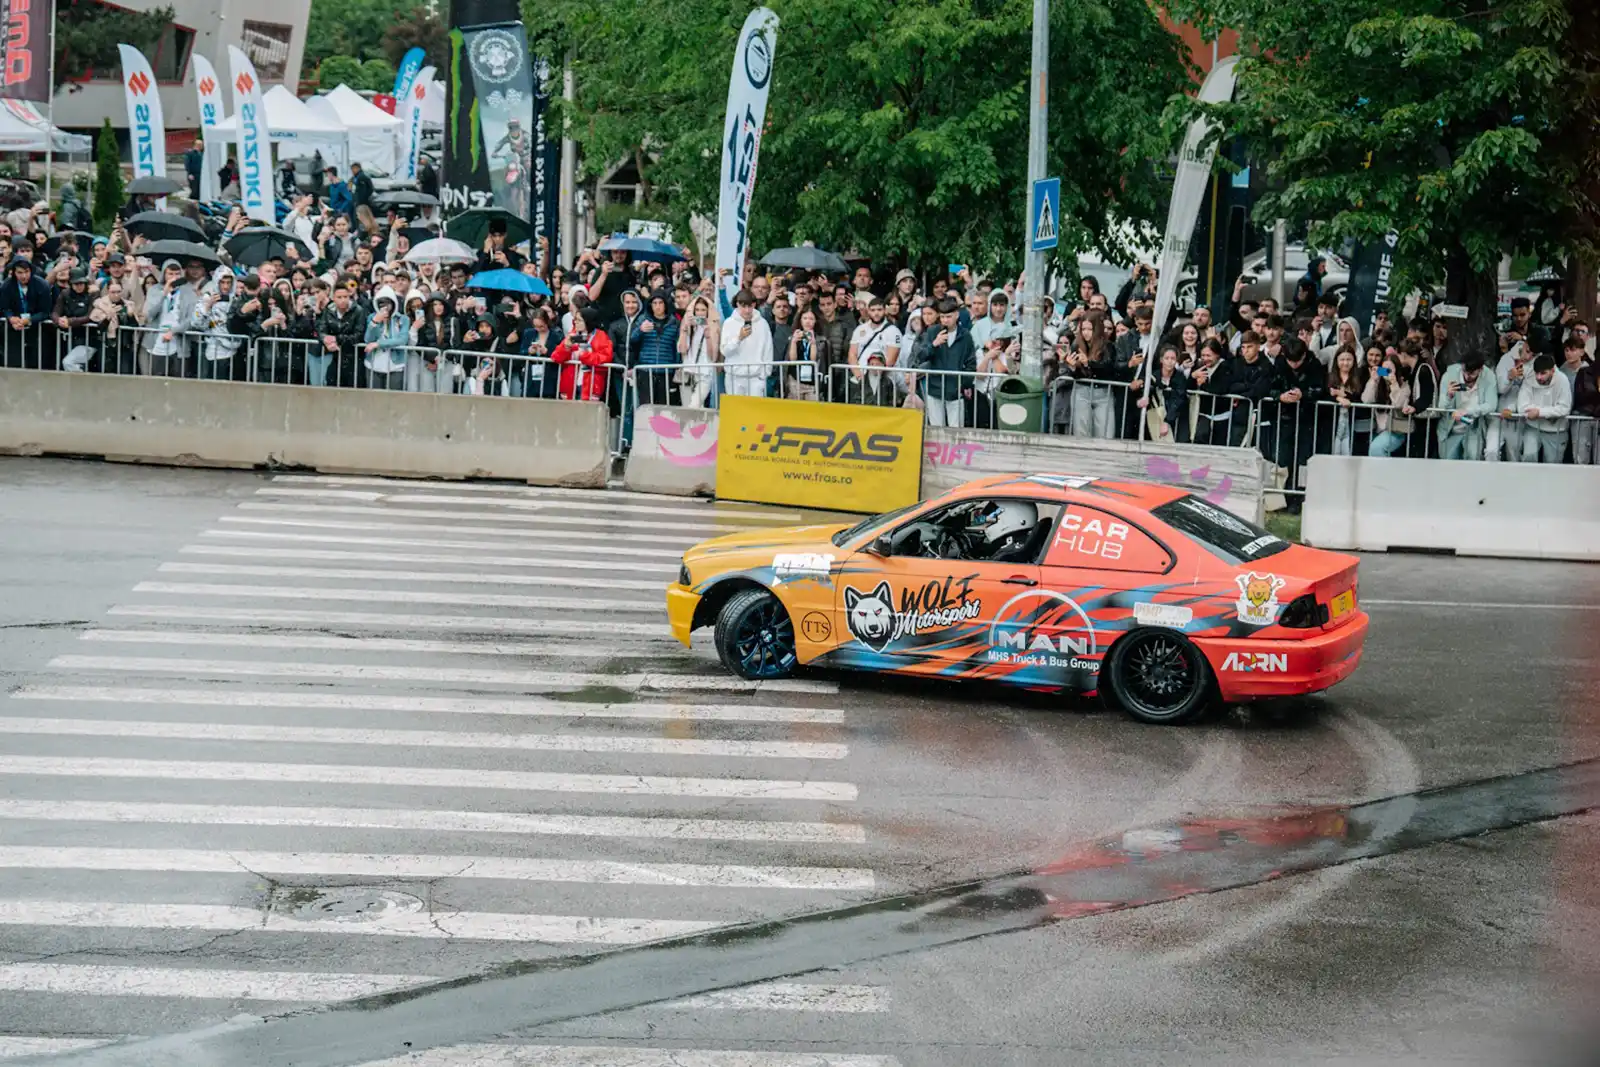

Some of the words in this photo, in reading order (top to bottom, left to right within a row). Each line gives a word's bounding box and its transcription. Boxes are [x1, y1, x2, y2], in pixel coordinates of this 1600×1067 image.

[769, 426, 903, 462] FRAS
[783, 470, 853, 484] www.fras.ro
[1060, 513, 1129, 540] CAR
[1054, 531, 1123, 560] HUB
[901, 573, 980, 612] WOLF
[804, 620, 830, 635] TTS
[893, 599, 981, 640] Motorsport
[998, 630, 1088, 656] MAN
[987, 650, 1010, 662] MHS
[1011, 653, 1038, 666] Truck
[1039, 656, 1047, 667] &
[1049, 656, 1069, 669] Bus
[1070, 658, 1100, 672] Group
